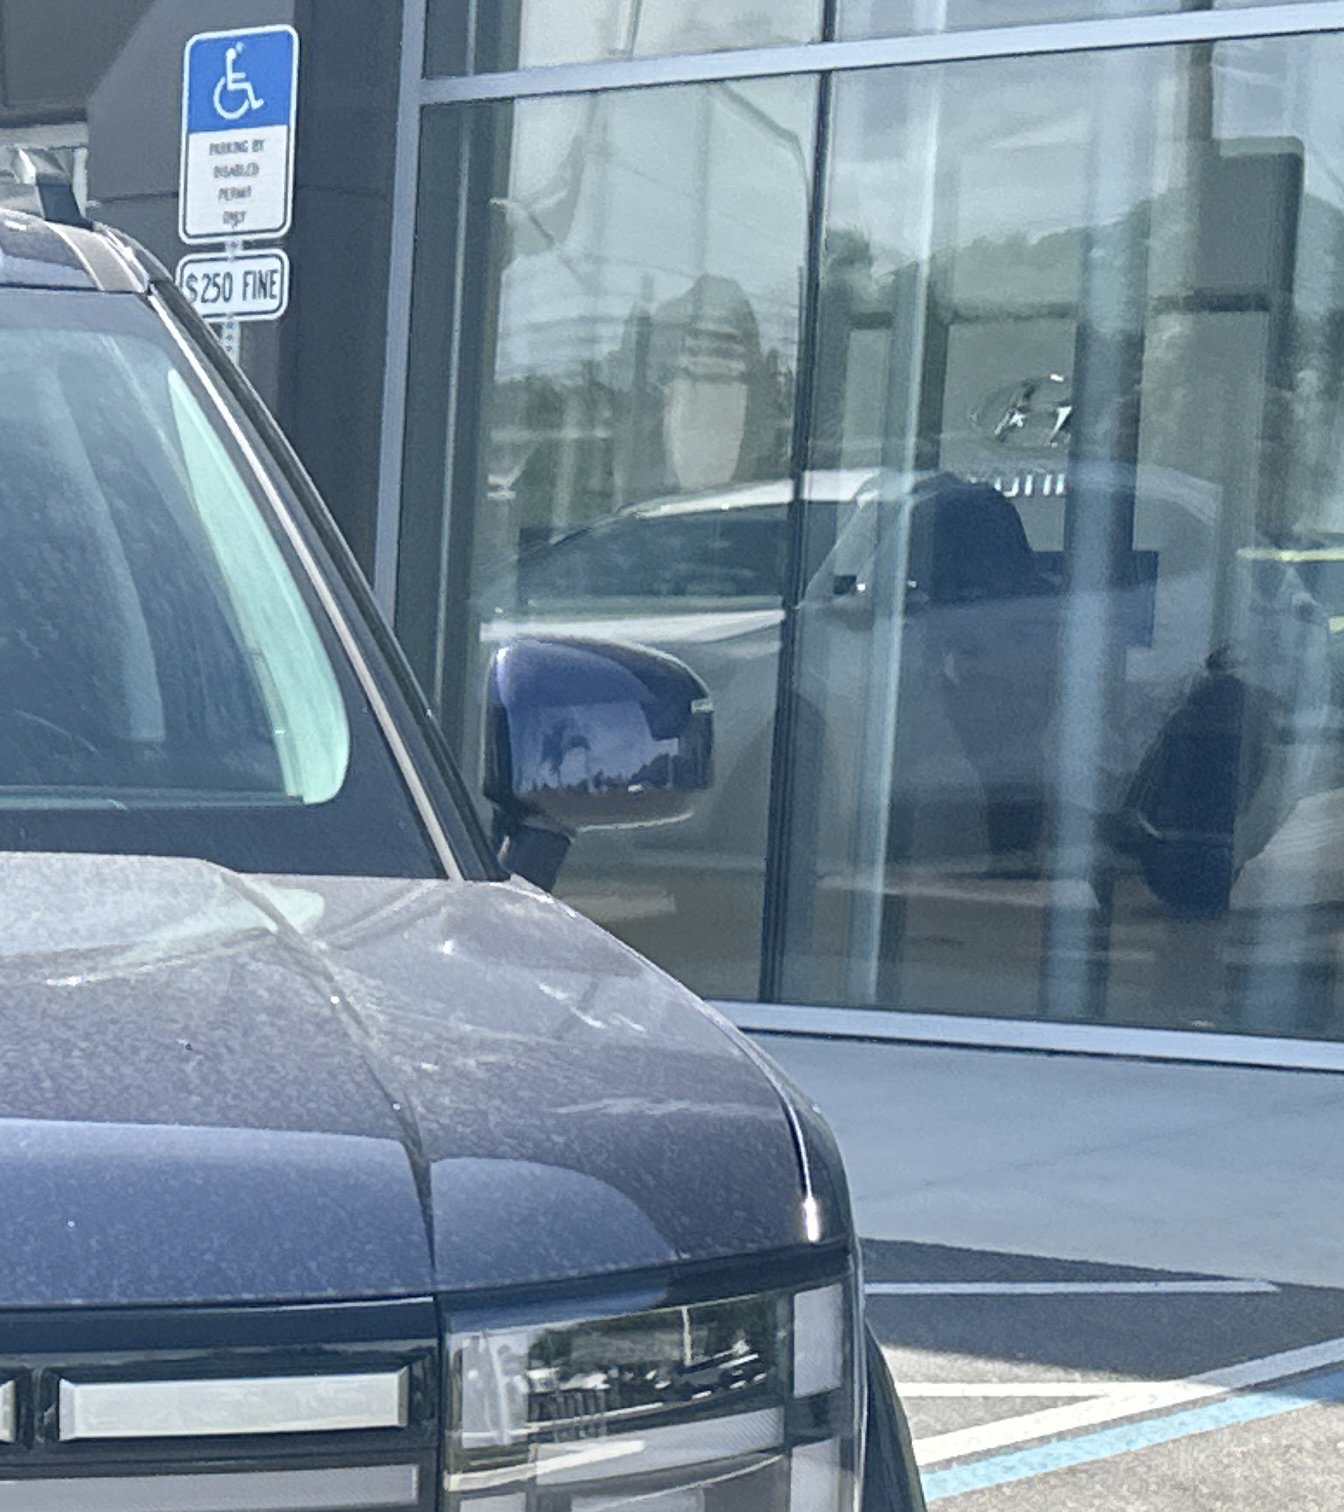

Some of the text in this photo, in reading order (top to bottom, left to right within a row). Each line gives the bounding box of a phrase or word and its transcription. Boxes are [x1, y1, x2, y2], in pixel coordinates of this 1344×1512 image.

[209, 140, 248, 156] PARKING
[214, 162, 259, 178] DISABLED
[218, 185, 251, 202] PERMIT
[186, 268, 279, 304] $250 FINE
